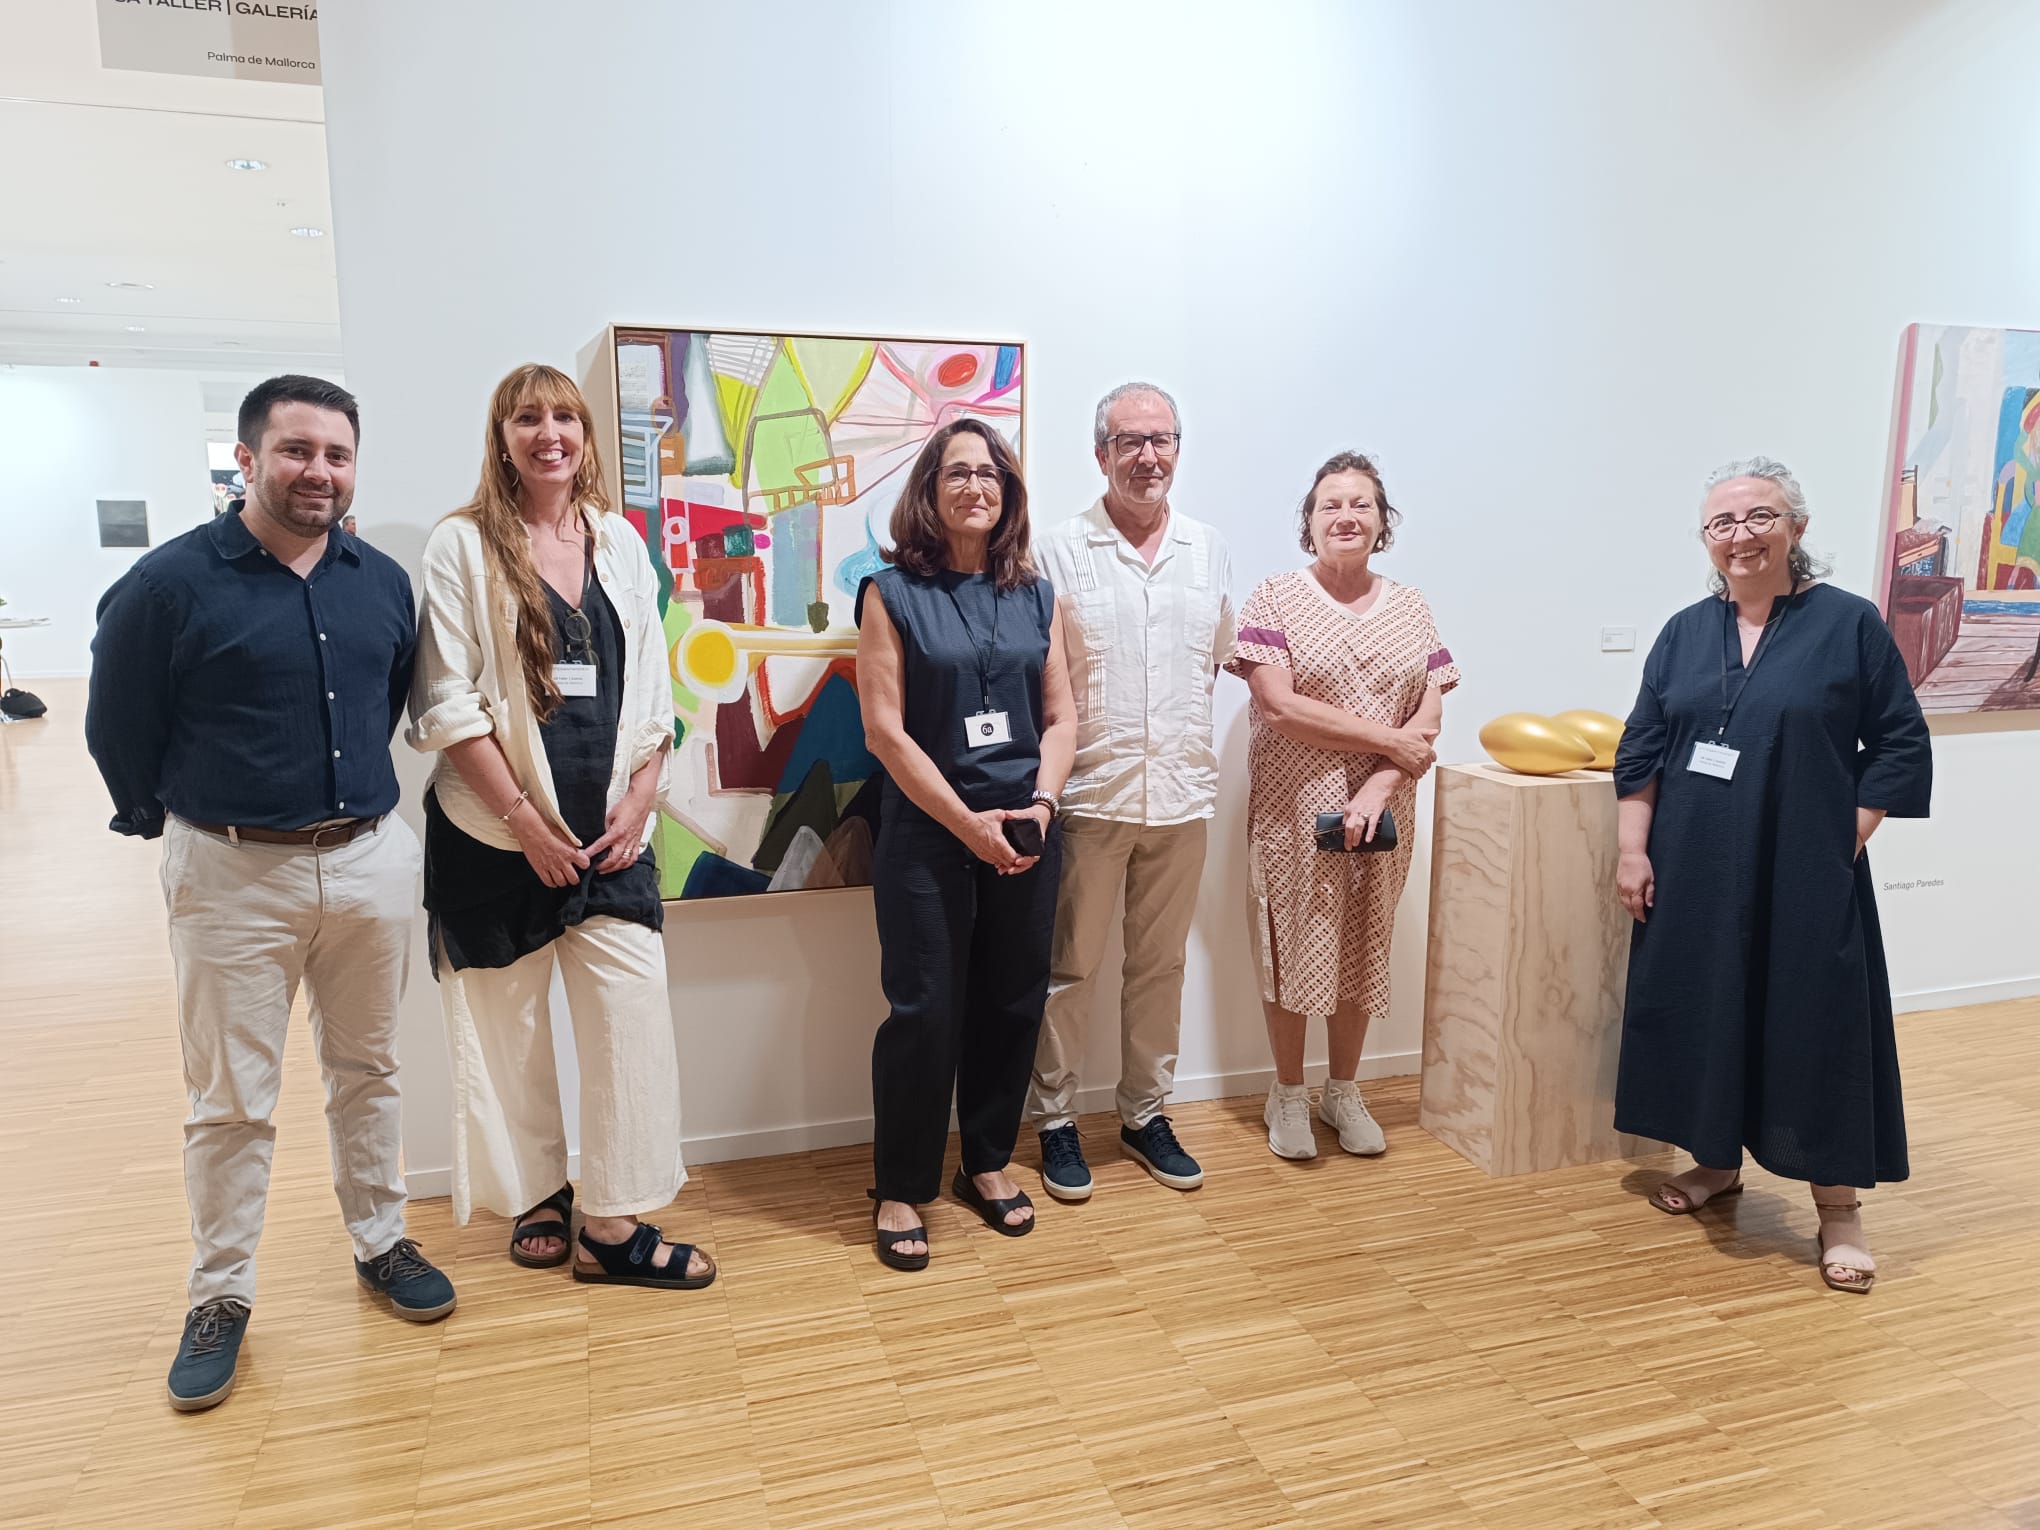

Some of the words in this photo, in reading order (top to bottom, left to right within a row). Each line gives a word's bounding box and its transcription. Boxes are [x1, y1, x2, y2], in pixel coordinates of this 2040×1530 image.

[235, 2, 318, 20] GALERÍA
[207, 51, 245, 63] Palma
[247, 55, 263, 65] de
[265, 56, 316, 69] Mallorca
[1883, 881, 1915, 892] Santiago
[1916, 878, 1944, 888] Paredes
